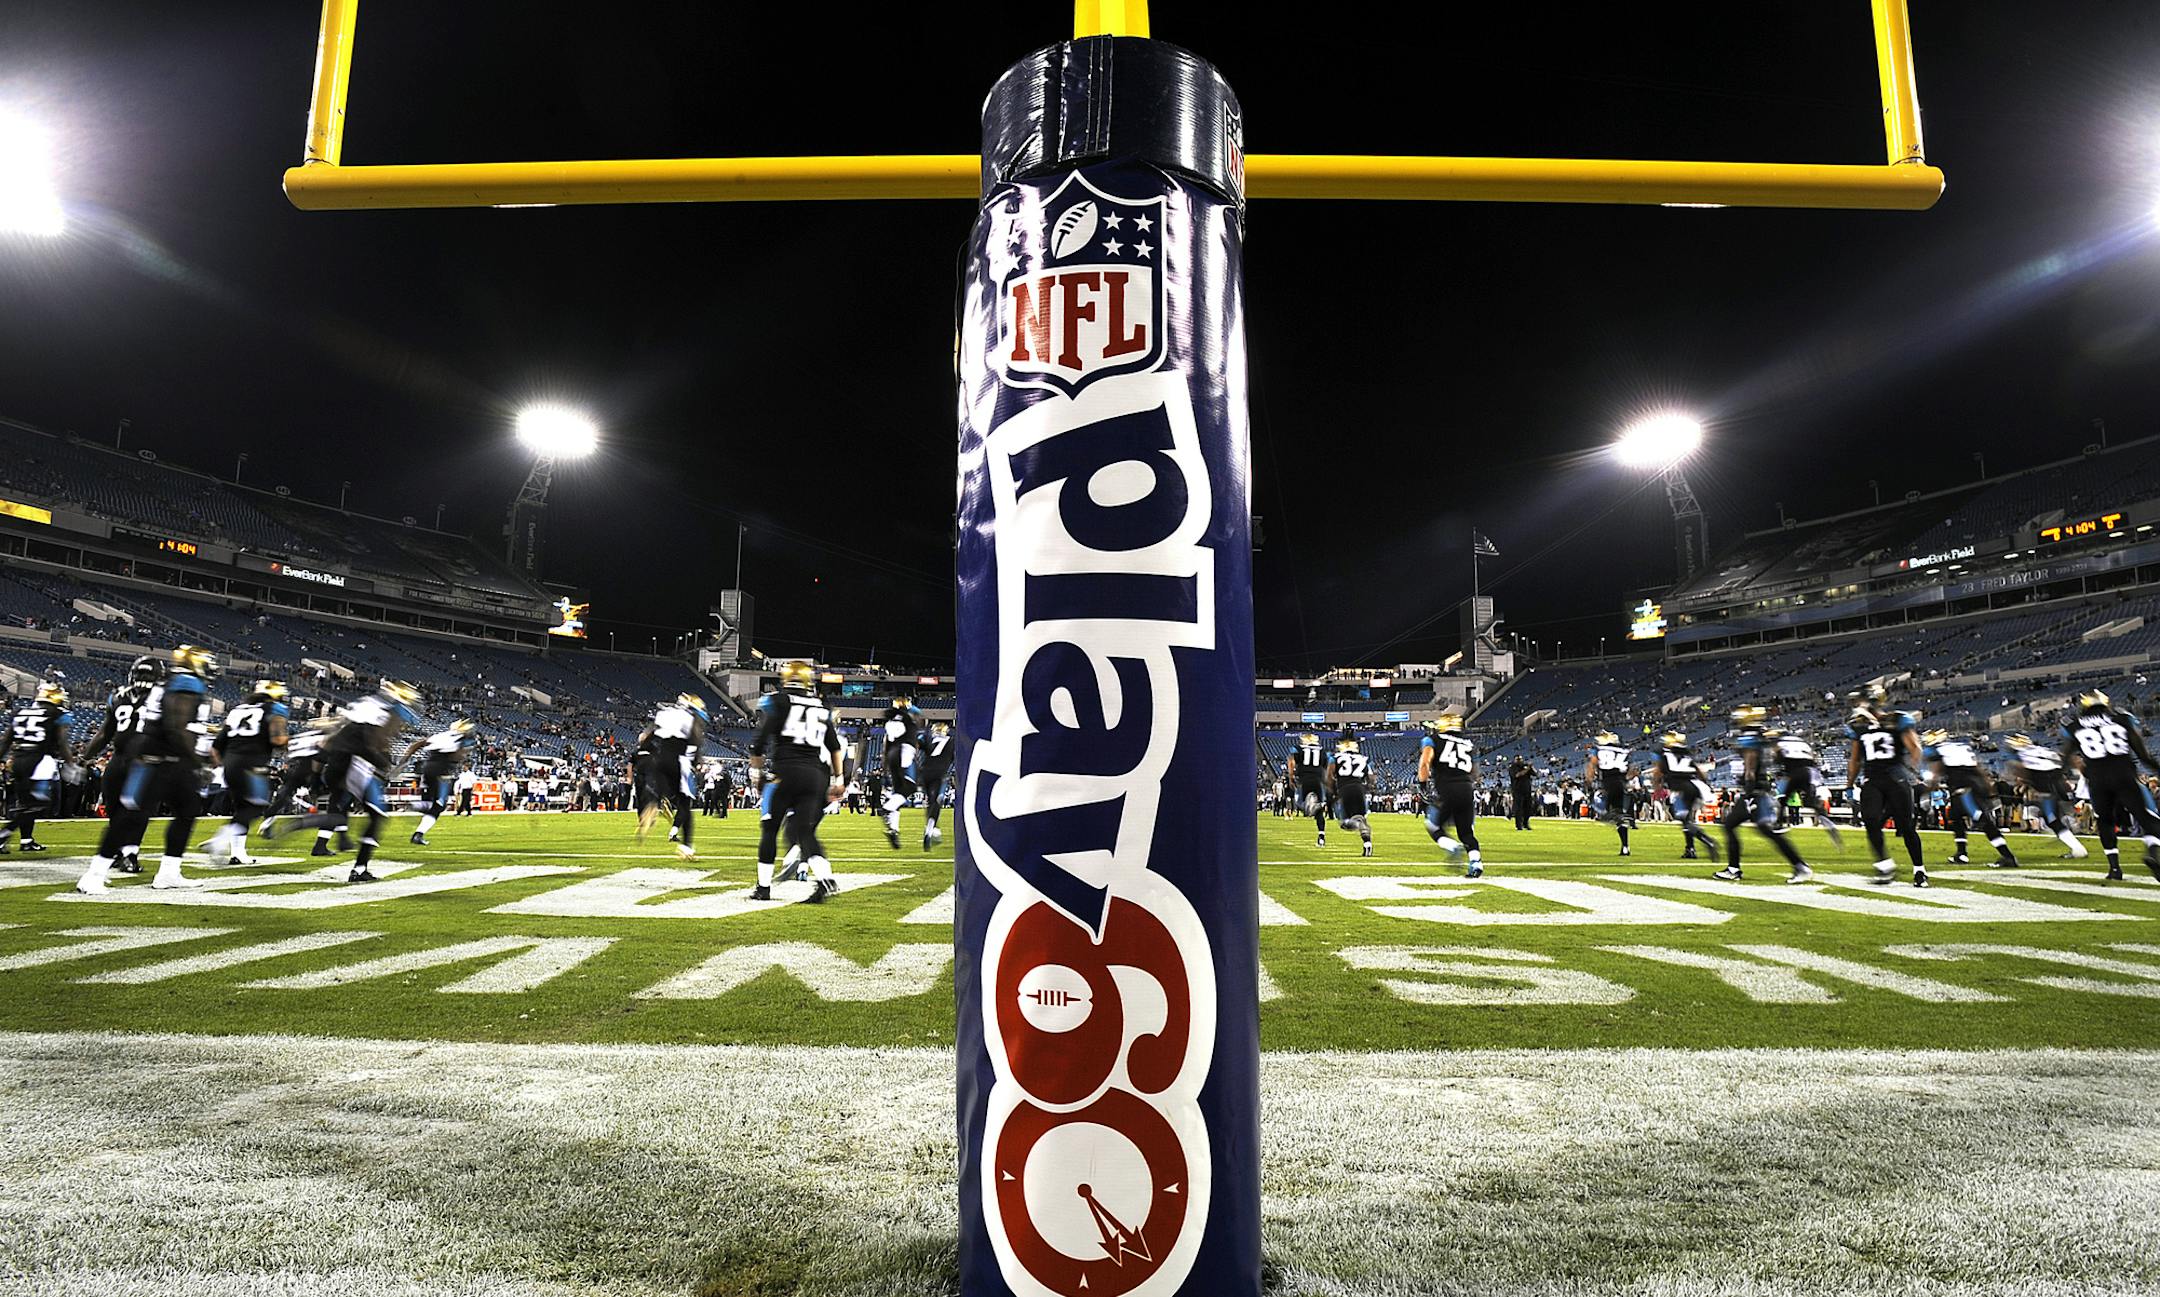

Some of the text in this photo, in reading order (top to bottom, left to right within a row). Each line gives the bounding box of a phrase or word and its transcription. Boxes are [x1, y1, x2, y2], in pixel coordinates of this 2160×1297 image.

[1011, 271, 1147, 372] NFL
[2065, 520, 2097, 536] 41:04
[167, 540, 196, 555] 41:04
[1909, 545, 1975, 569] EverBank Field
[282, 565, 345, 587] EverBank Field
[1981, 576, 2006, 590] FRED
[2010, 568, 2049, 585] TAYLOR
[781, 704, 830, 747] 46
[1439, 741, 1473, 773] 45
